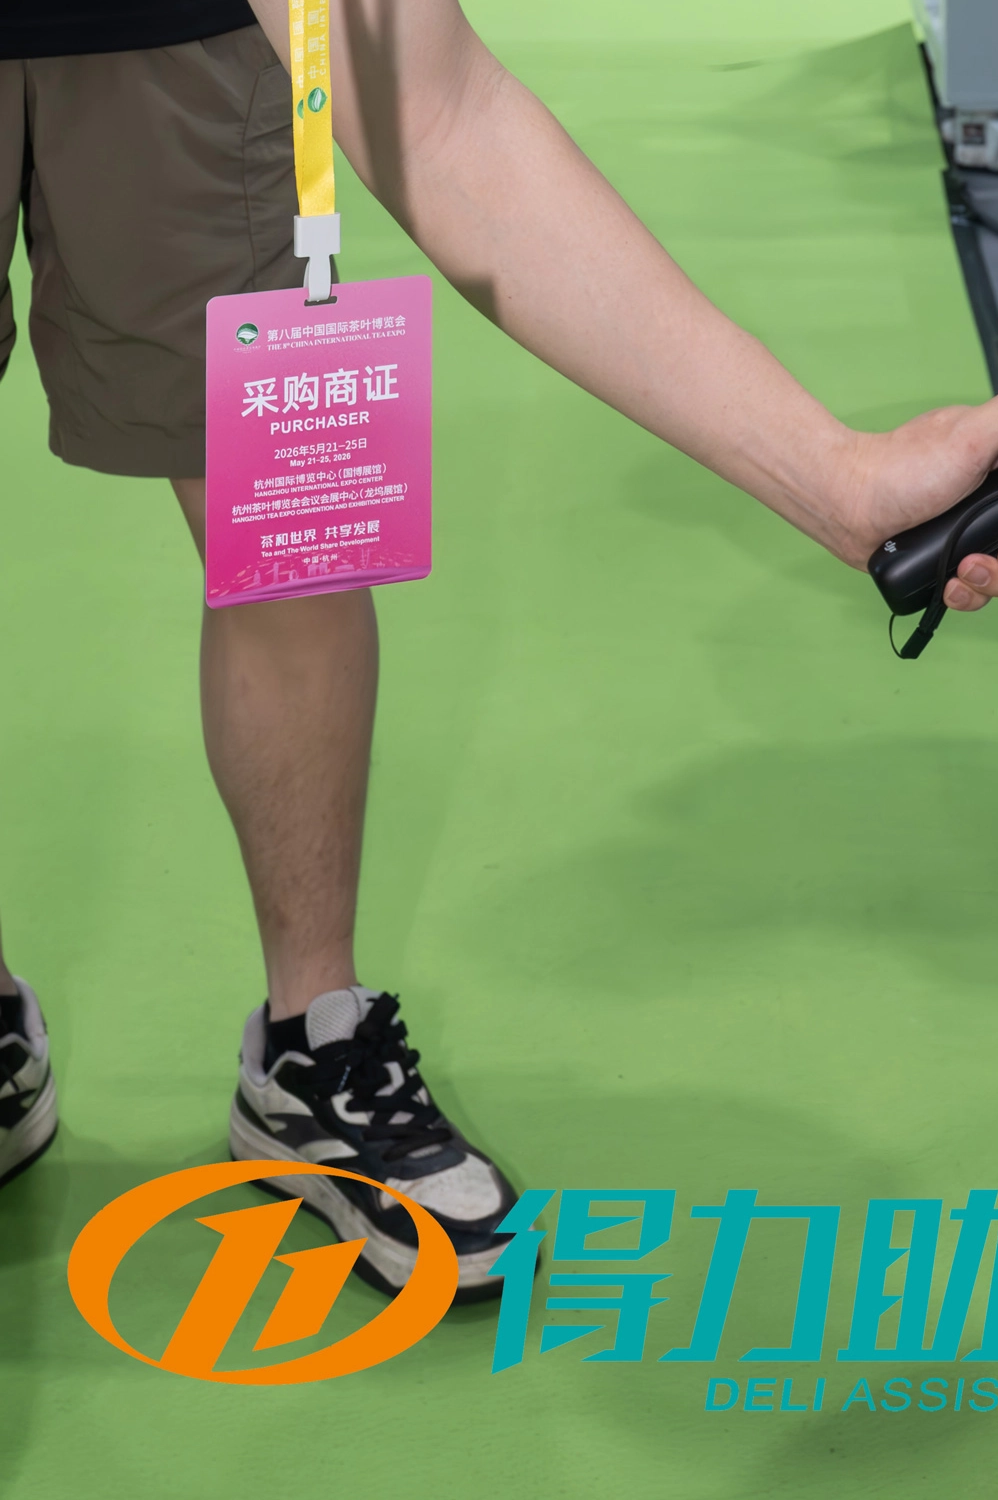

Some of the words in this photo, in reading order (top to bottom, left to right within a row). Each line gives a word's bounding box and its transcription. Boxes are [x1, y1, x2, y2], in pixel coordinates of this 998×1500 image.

[319, 33, 327, 76] CHINA
[267, 315, 406, 342] 第八届中国国际茶叶博览会
[267, 343, 282, 351] THE
[290, 340, 314, 349] CHINA
[314, 333, 371, 346] INTERNATIONAL
[371, 331, 386, 339] TEA
[386, 329, 406, 338] EXPO
[241, 363, 399, 418] 采购商证
[270, 411, 370, 436] PURCHASER
[290, 458, 305, 468] May
[333, 453, 351, 462] 2026
[254, 487, 289, 498] HANGZHOU
[290, 481, 339, 493] INTERNATIONAL
[340, 479, 357, 487] EXPO
[358, 475, 383, 485] CENTER
[232, 513, 266, 524] HANGZHOU
[267, 511, 279, 519] TEA
[279, 508, 296, 517] EXPO
[296, 503, 334, 515] CONVENTION
[334, 502, 348, 510] AND
[348, 498, 381, 509] EXHIBITION
[381, 495, 405, 504] CENTER
[261, 528, 317, 549] 茶和世界
[324, 519, 380, 540] 共享发展
[287, 547, 299, 555] The
[300, 544, 318, 553] World
[320, 541, 338, 550] Share
[339, 536, 380, 547] Development
